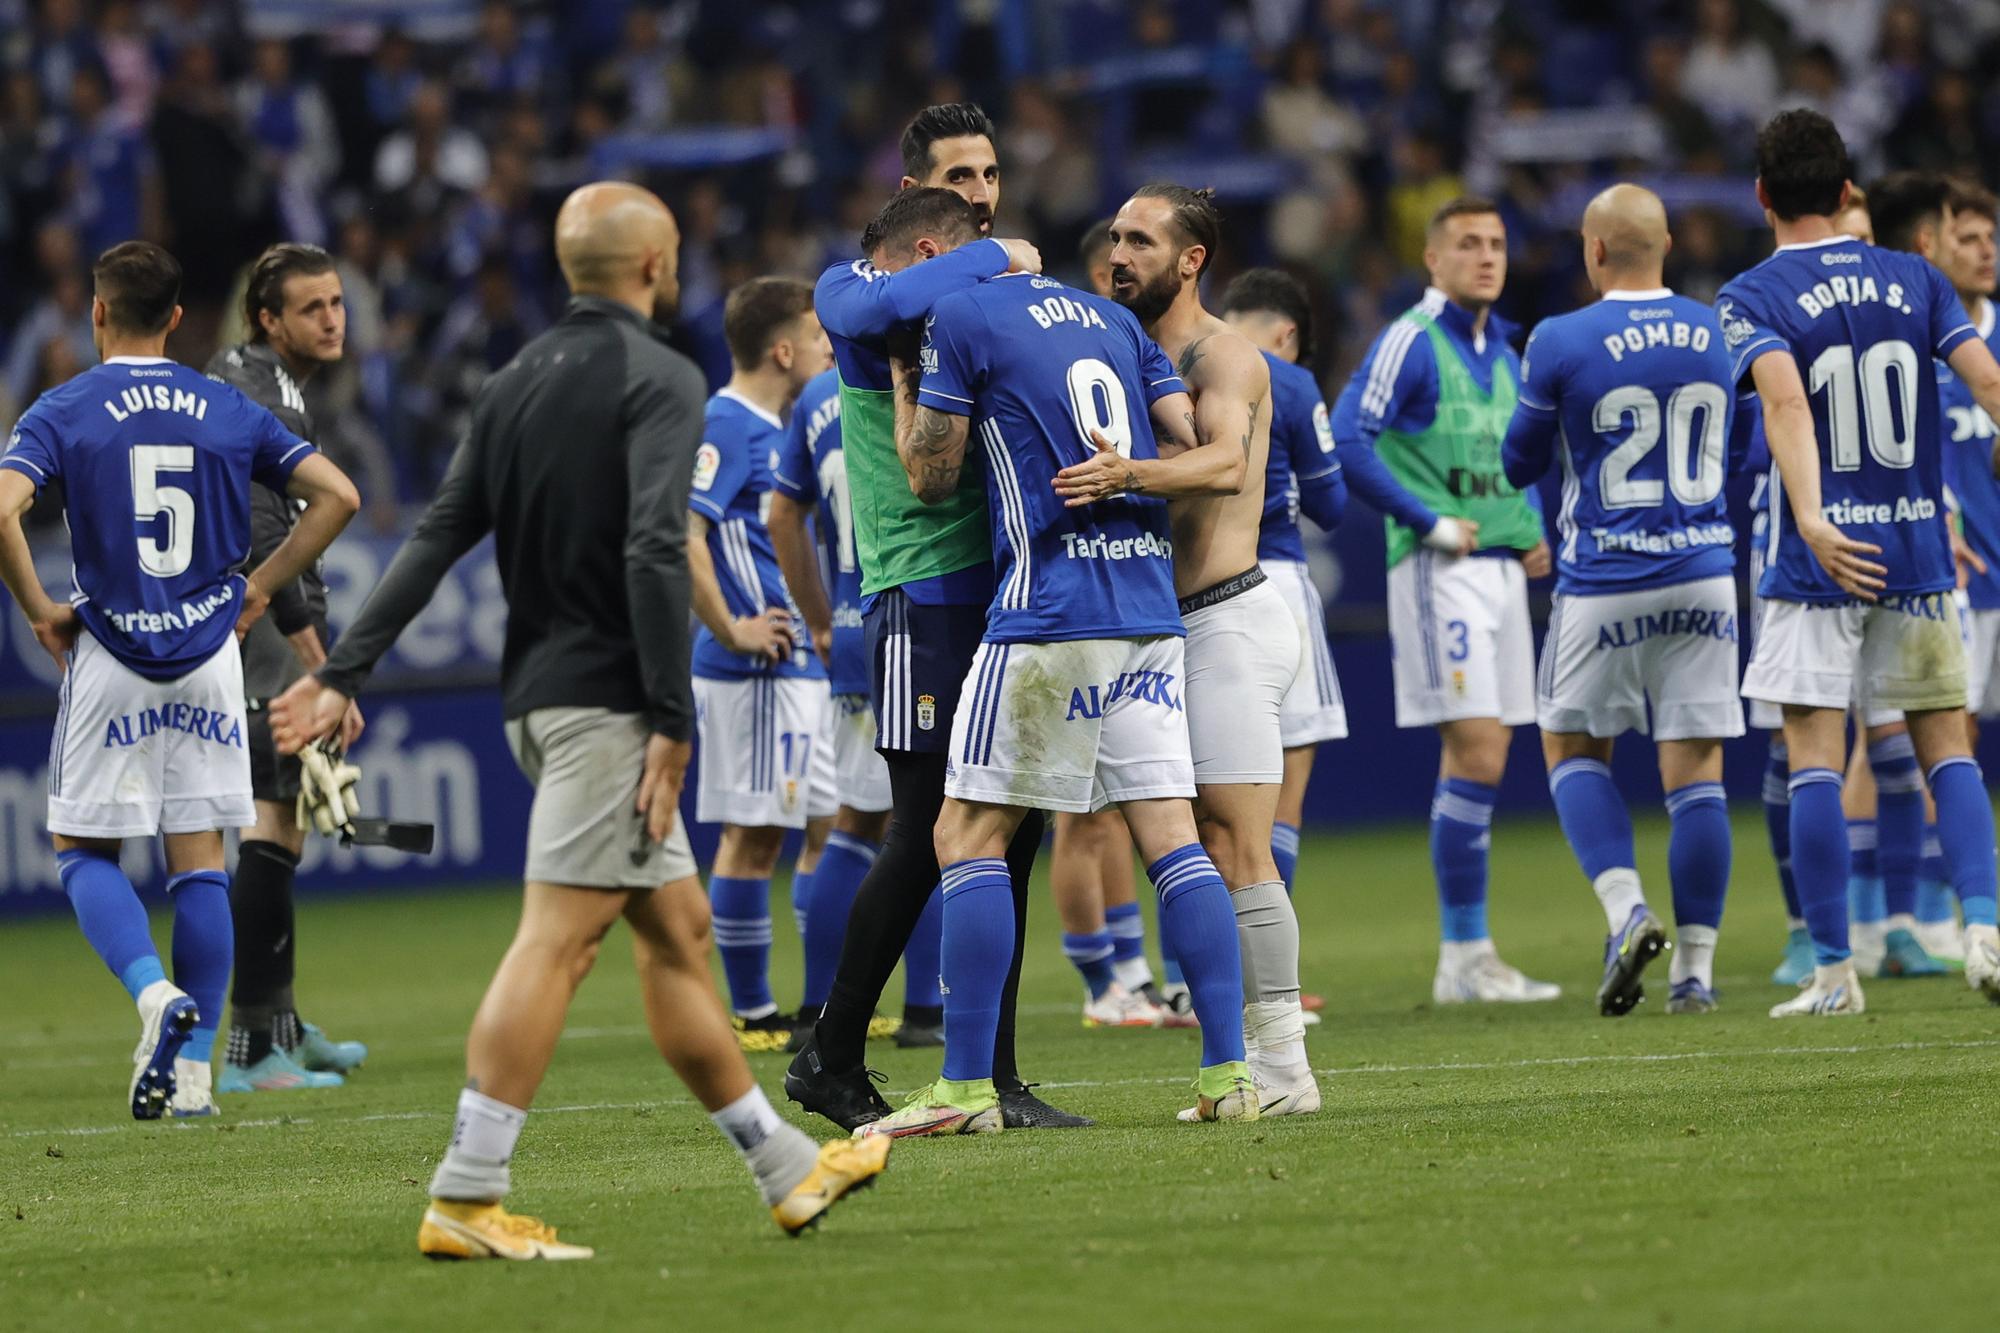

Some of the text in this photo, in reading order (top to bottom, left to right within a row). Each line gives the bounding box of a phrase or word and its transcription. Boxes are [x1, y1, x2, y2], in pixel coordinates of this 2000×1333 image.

[1027, 296, 1108, 330] BORJA
[1797, 276, 1913, 319] BORJA S.
[1603, 321, 1711, 363] POMBO
[103, 384, 209, 423] LUISMI
[1808, 339, 1919, 473] 10
[1065, 358, 1132, 498] 9
[1591, 381, 1728, 511] 20
[129, 444, 196, 578] 5
[1203, 580, 1241, 605] NIKE
[1446, 620, 1469, 662] 3
[1598, 608, 1739, 650] ALIMERKA
[104, 703, 243, 748] ALIMERKA
[780, 732, 812, 778] 17
